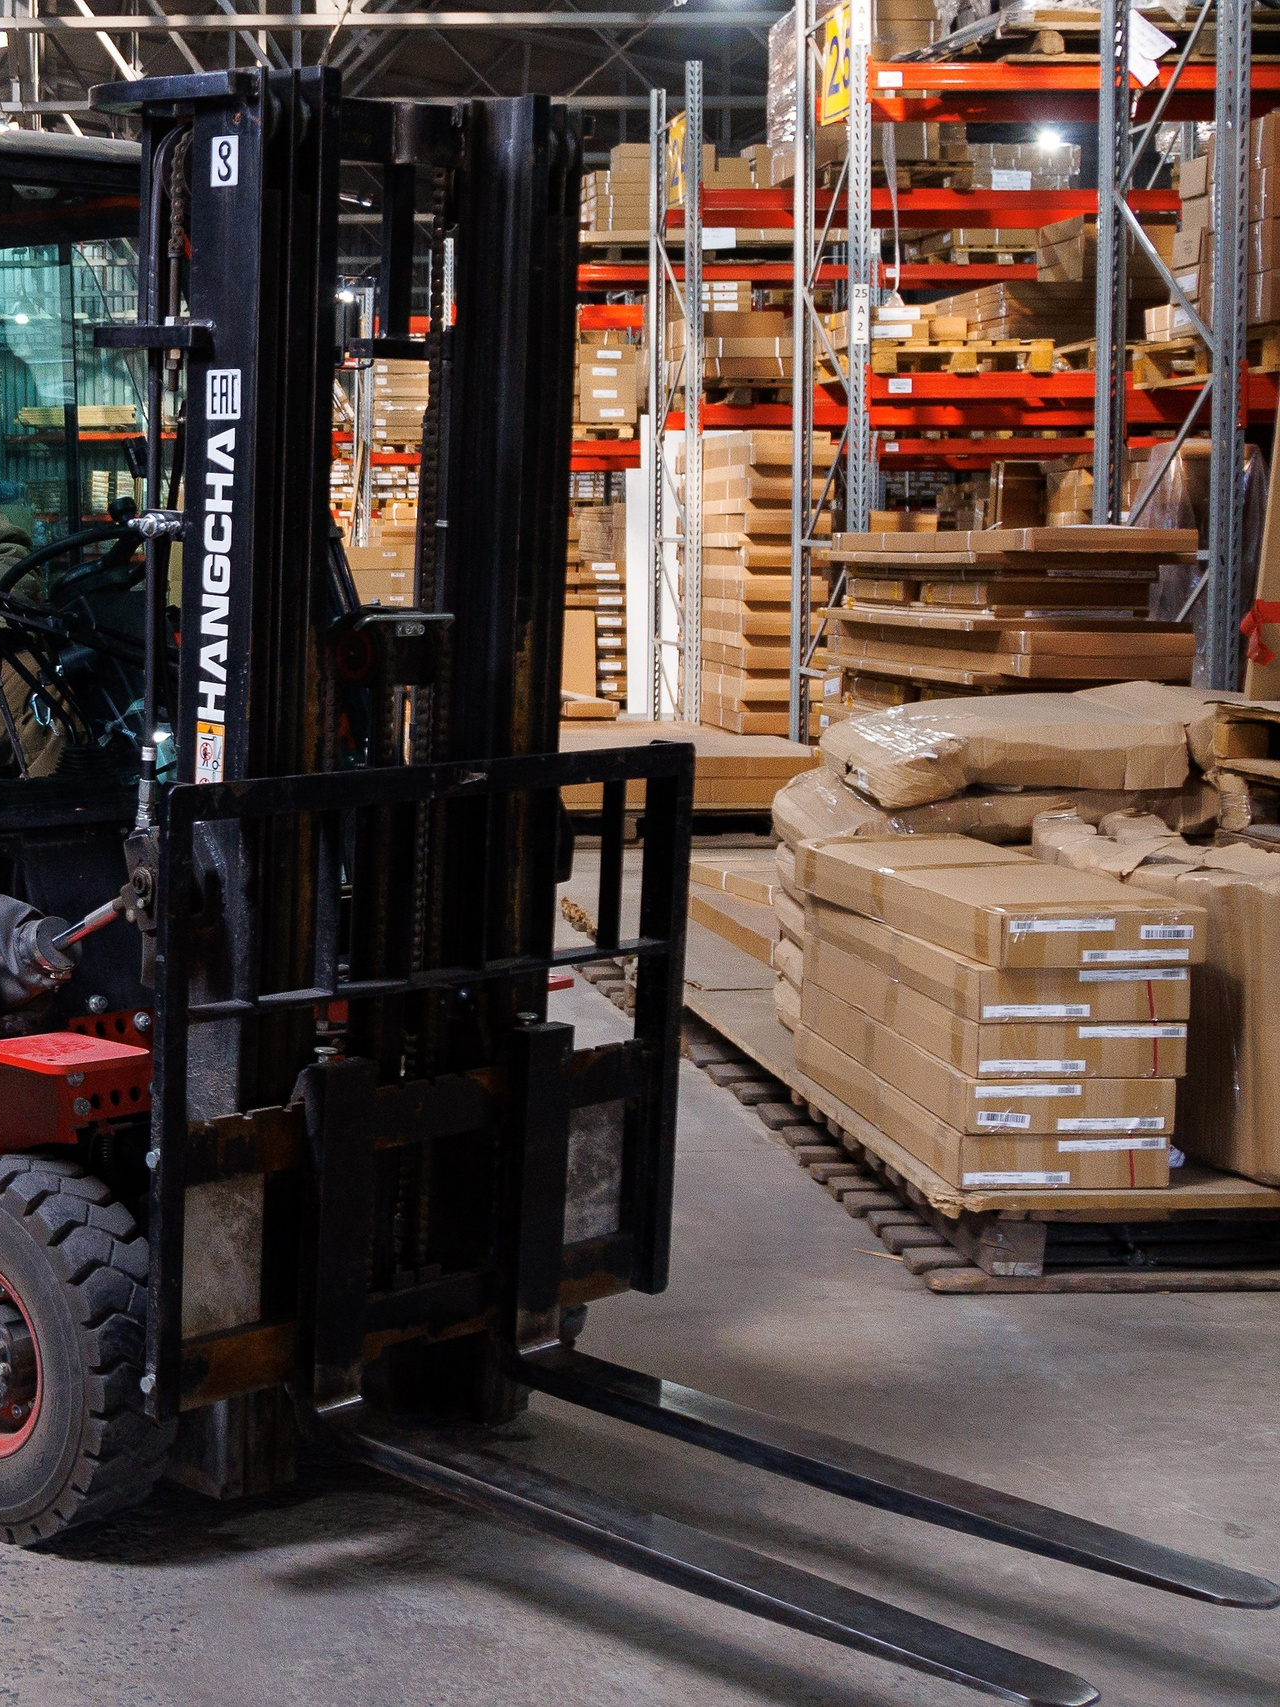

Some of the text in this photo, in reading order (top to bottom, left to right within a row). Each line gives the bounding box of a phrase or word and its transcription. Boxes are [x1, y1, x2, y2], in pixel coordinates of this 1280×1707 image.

[854, 288, 868, 299] 25
[857, 305, 866, 315] A
[857, 321, 864, 332] 2
[211, 375, 238, 415] EAC
[197, 427, 236, 723] HANGCHA
